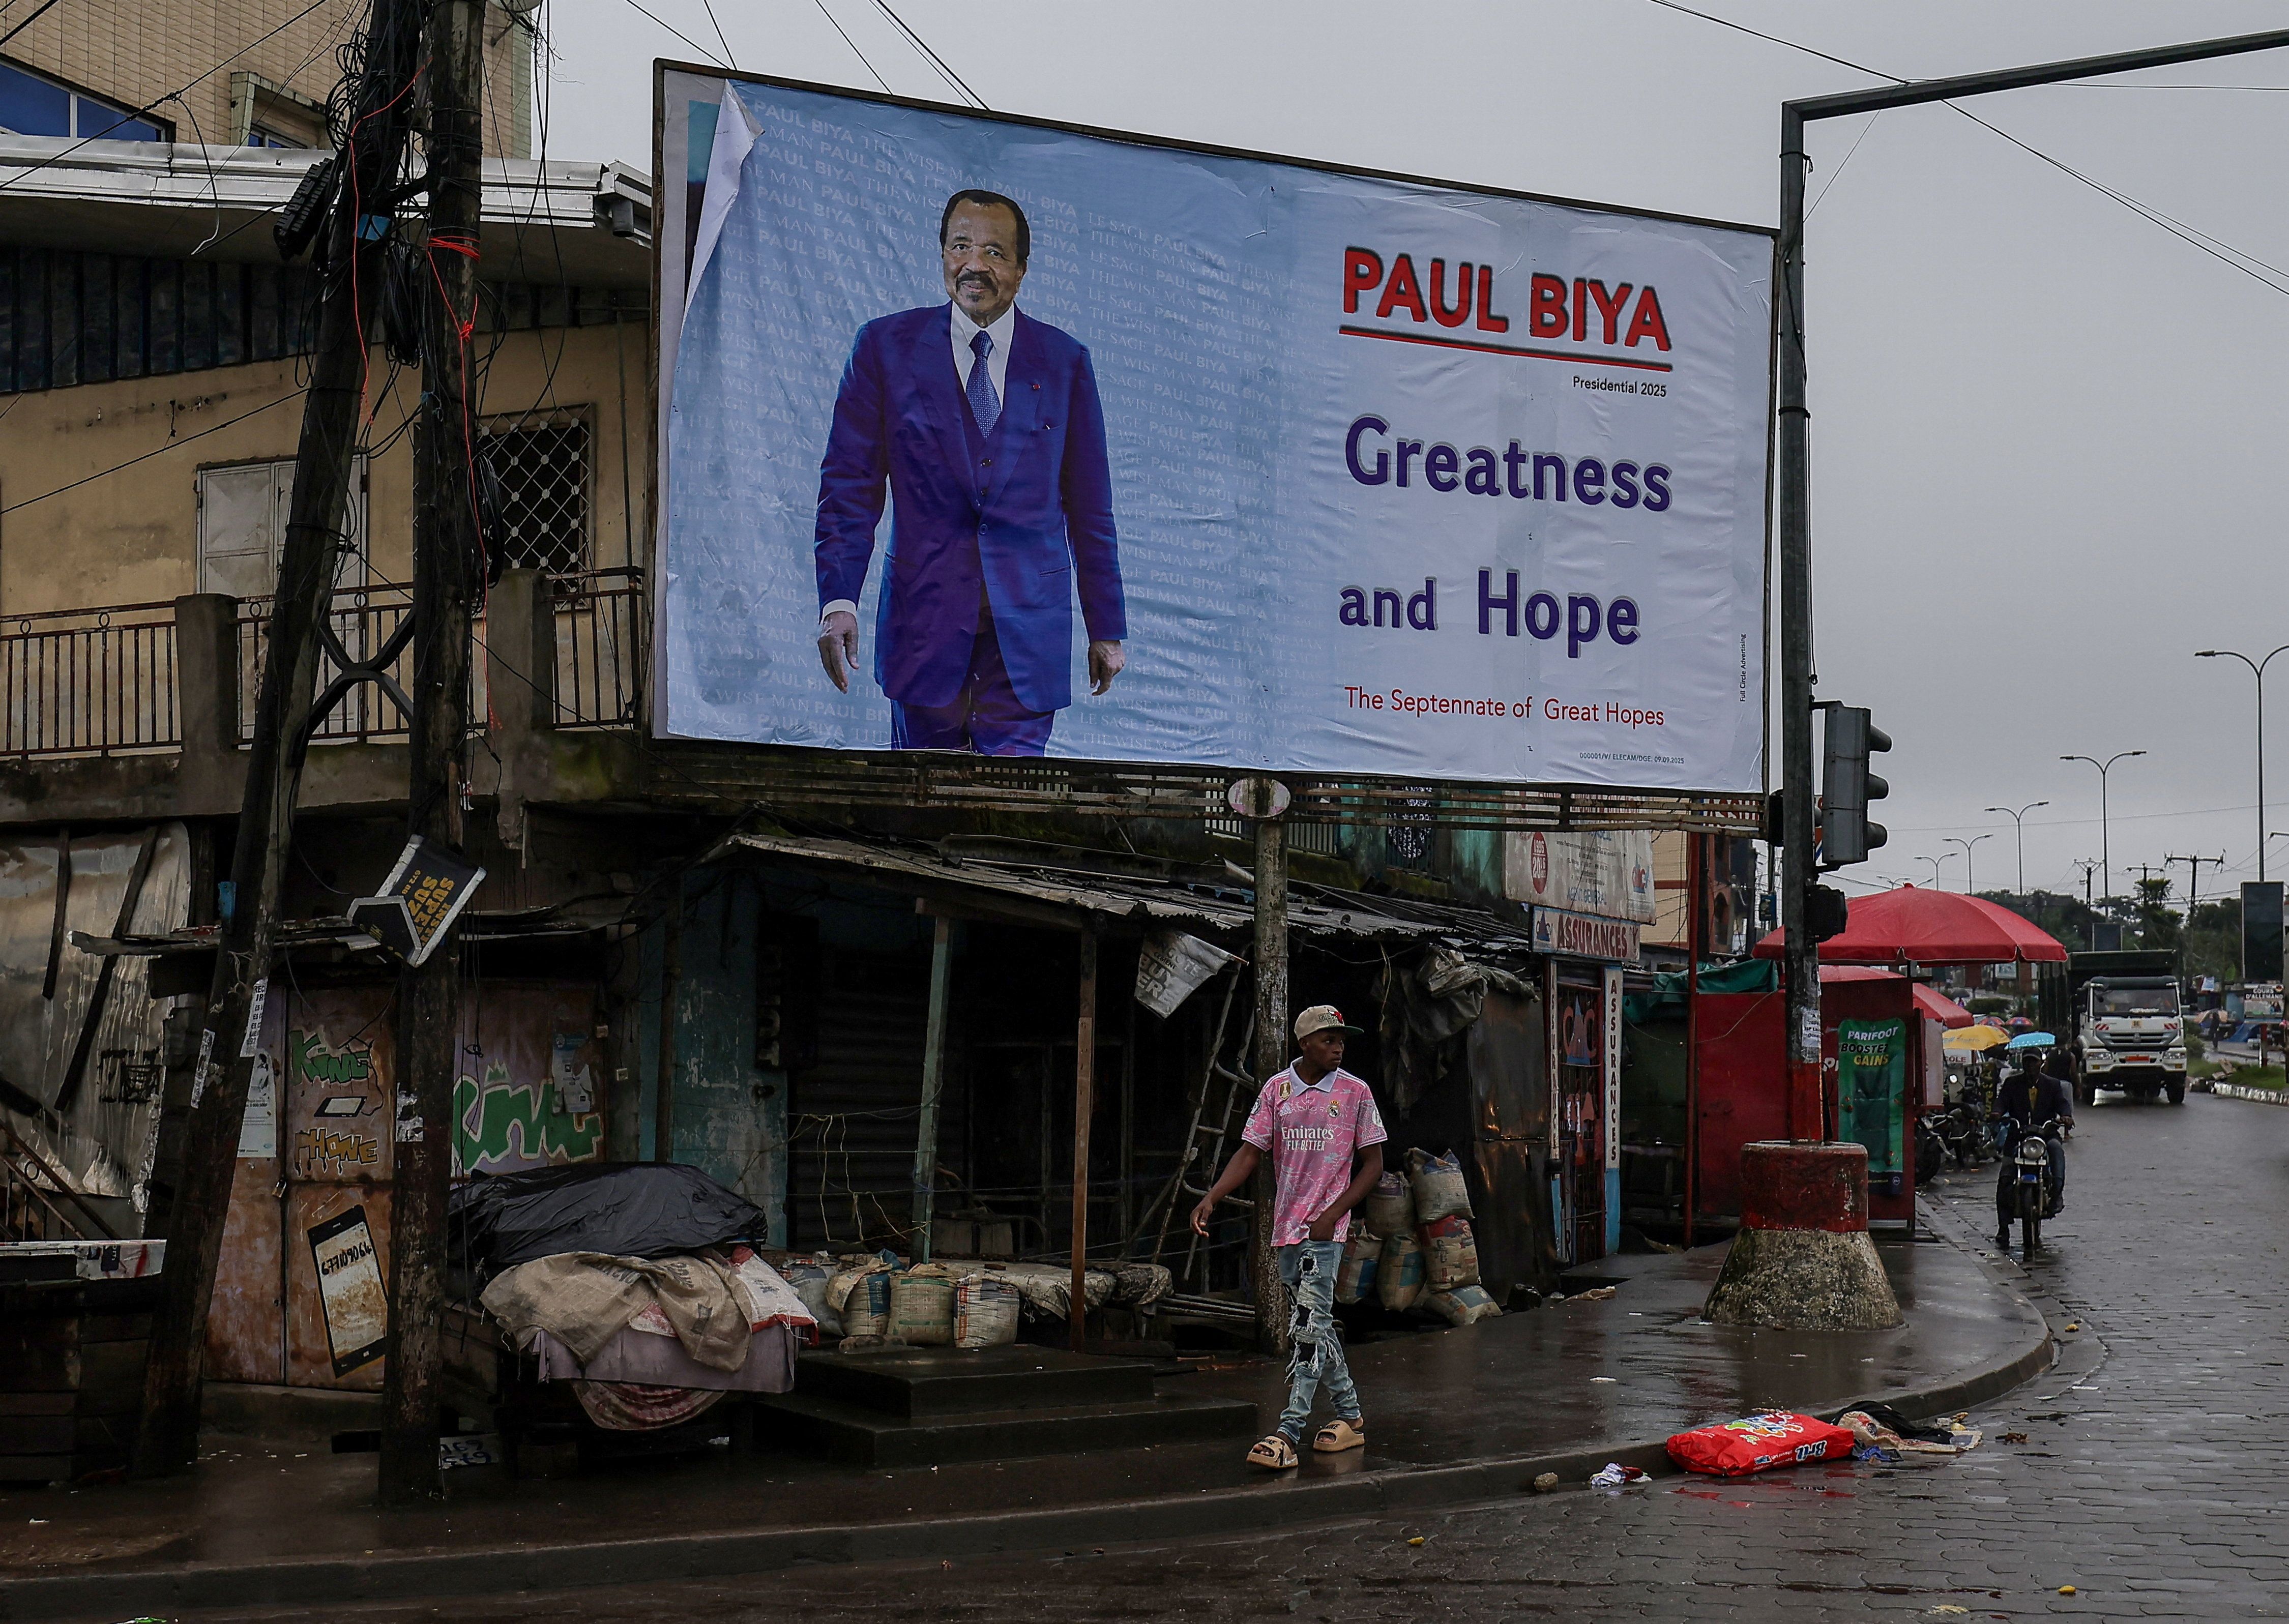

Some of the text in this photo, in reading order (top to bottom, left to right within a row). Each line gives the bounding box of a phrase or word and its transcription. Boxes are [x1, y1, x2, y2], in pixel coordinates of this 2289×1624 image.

[755, 101, 805, 128] PAUL
[812, 119, 854, 143] BIYA
[1041, 196, 1077, 217] BIYA
[758, 142, 808, 169] PAUL
[815, 161, 856, 183] BIYA
[770, 126, 915, 183] MAN PAUL BIYA
[815, 203, 855, 227] BIYA
[821, 186, 868, 210] PAUL
[876, 204, 916, 226] BIYA
[758, 230, 808, 255] PAUL
[816, 247, 856, 269] BIYA
[1044, 256, 1080, 275] BIYA
[1041, 272, 1077, 293] BIYA
[1156, 271, 1193, 292] PAUL
[1046, 295, 1081, 315] BIYA
[1342, 246, 1671, 351] PAUL BIYA
[1155, 344, 1192, 365] PAUL
[1196, 356, 1227, 374] BIYA
[1573, 376, 1667, 398] Presidential 2025
[1345, 413, 1672, 512] Greatness
[1339, 567, 1641, 659] and Hope
[1345, 686, 1664, 730] The Septennate of Great Hopes
[1534, 839, 1545, 853] 1996
[1558, 914, 1627, 958] ASSURANCES
[1154, 952, 1177, 969] CEMENT
[1847, 1026, 1898, 1041] PARIFOOT
[1609, 979, 1618, 1162] ASSURANCES
[1854, 1054, 1889, 1066] GAINS
[1281, 1125, 1334, 1139] Emirates
[1287, 1140, 1325, 1151] FLY BETTER
